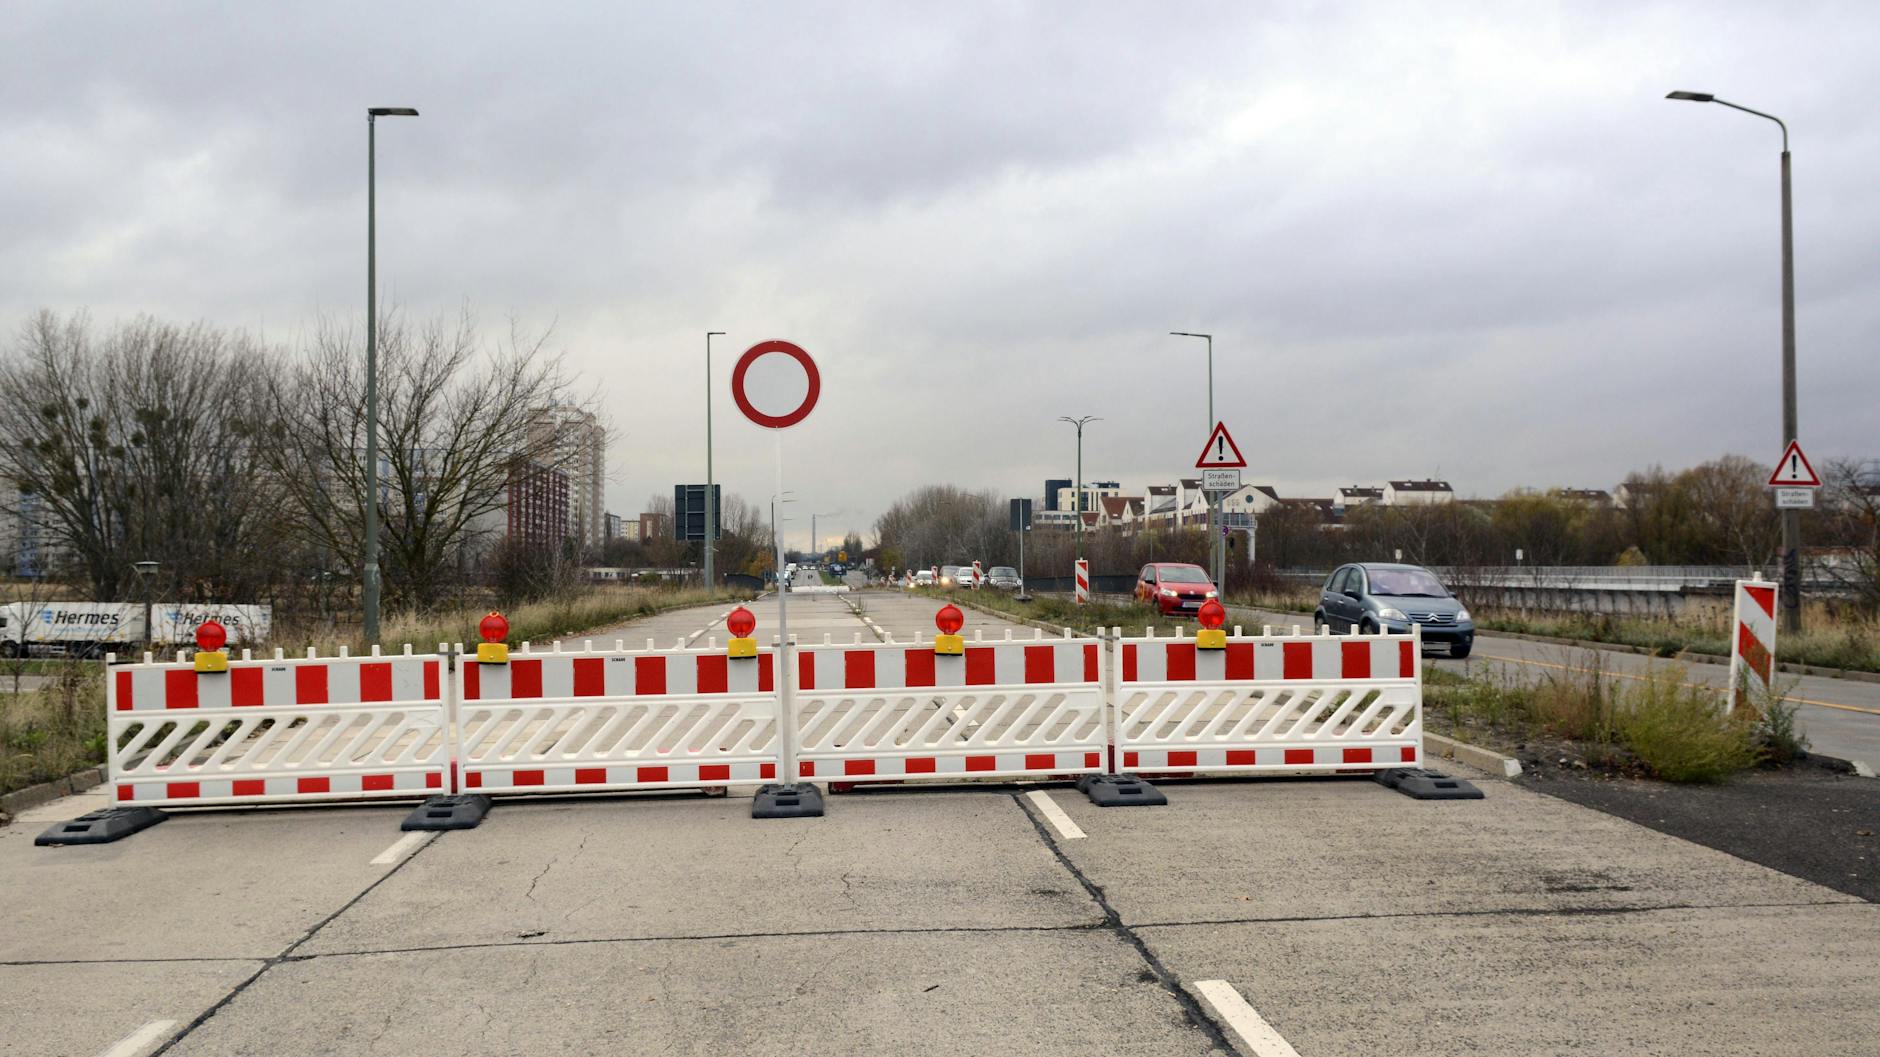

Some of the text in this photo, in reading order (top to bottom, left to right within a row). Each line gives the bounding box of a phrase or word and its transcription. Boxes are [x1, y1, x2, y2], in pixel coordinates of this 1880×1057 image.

[1208, 472, 1236, 480] Straßen-
[55, 610, 120, 625] Hermes
[183, 612, 240, 626] Hermes
